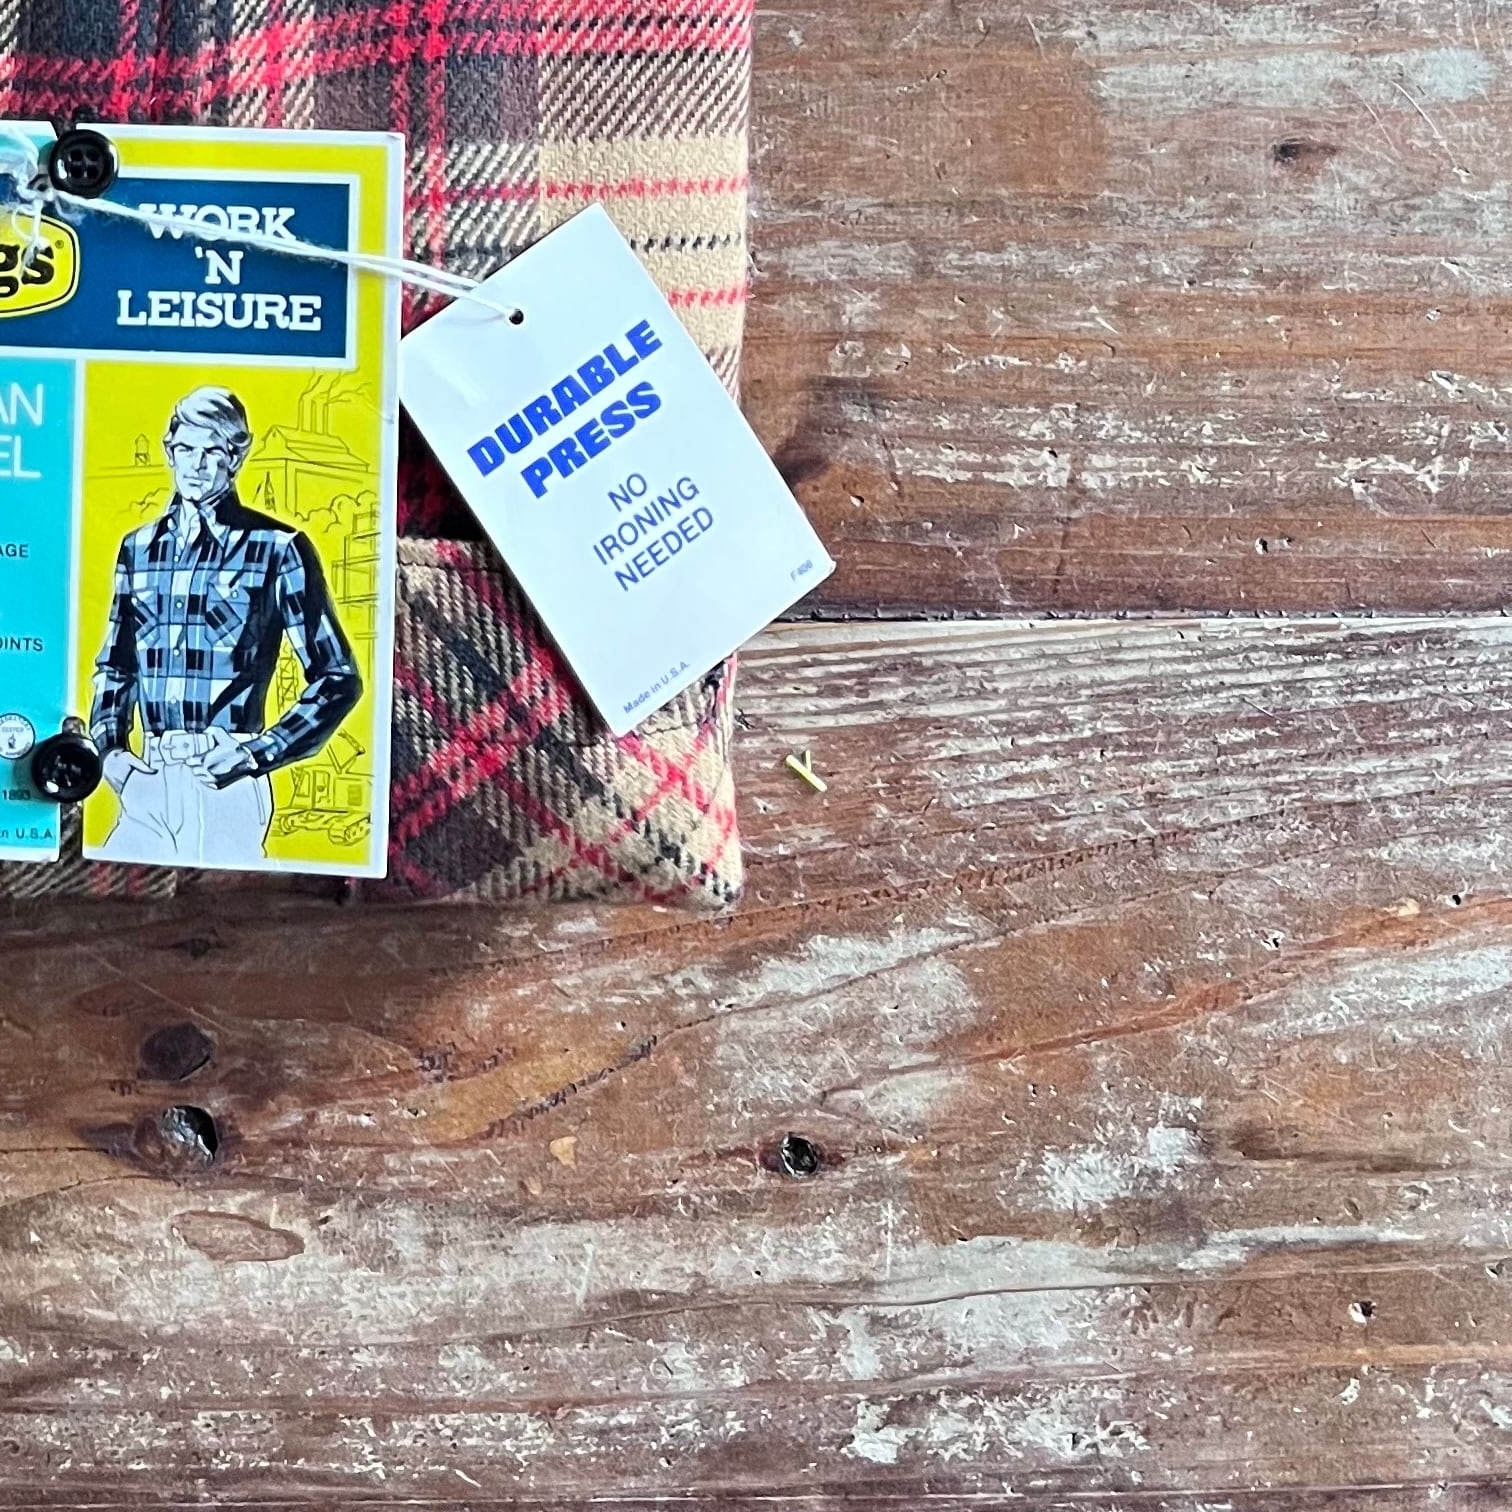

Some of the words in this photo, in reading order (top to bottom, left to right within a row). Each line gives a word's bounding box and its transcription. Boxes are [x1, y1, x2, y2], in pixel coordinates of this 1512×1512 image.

[138, 202, 297, 241] WORK
[117, 290, 322, 331] LEISURE
[466, 319, 663, 478] DURABLE
[519, 381, 662, 499] PRESS
[592, 476, 701, 567] IRONING
[607, 472, 649, 514] NO
[614, 506, 715, 592] NEEDED
[623, 690, 651, 714] Made
[650, 682, 662, 694] in
